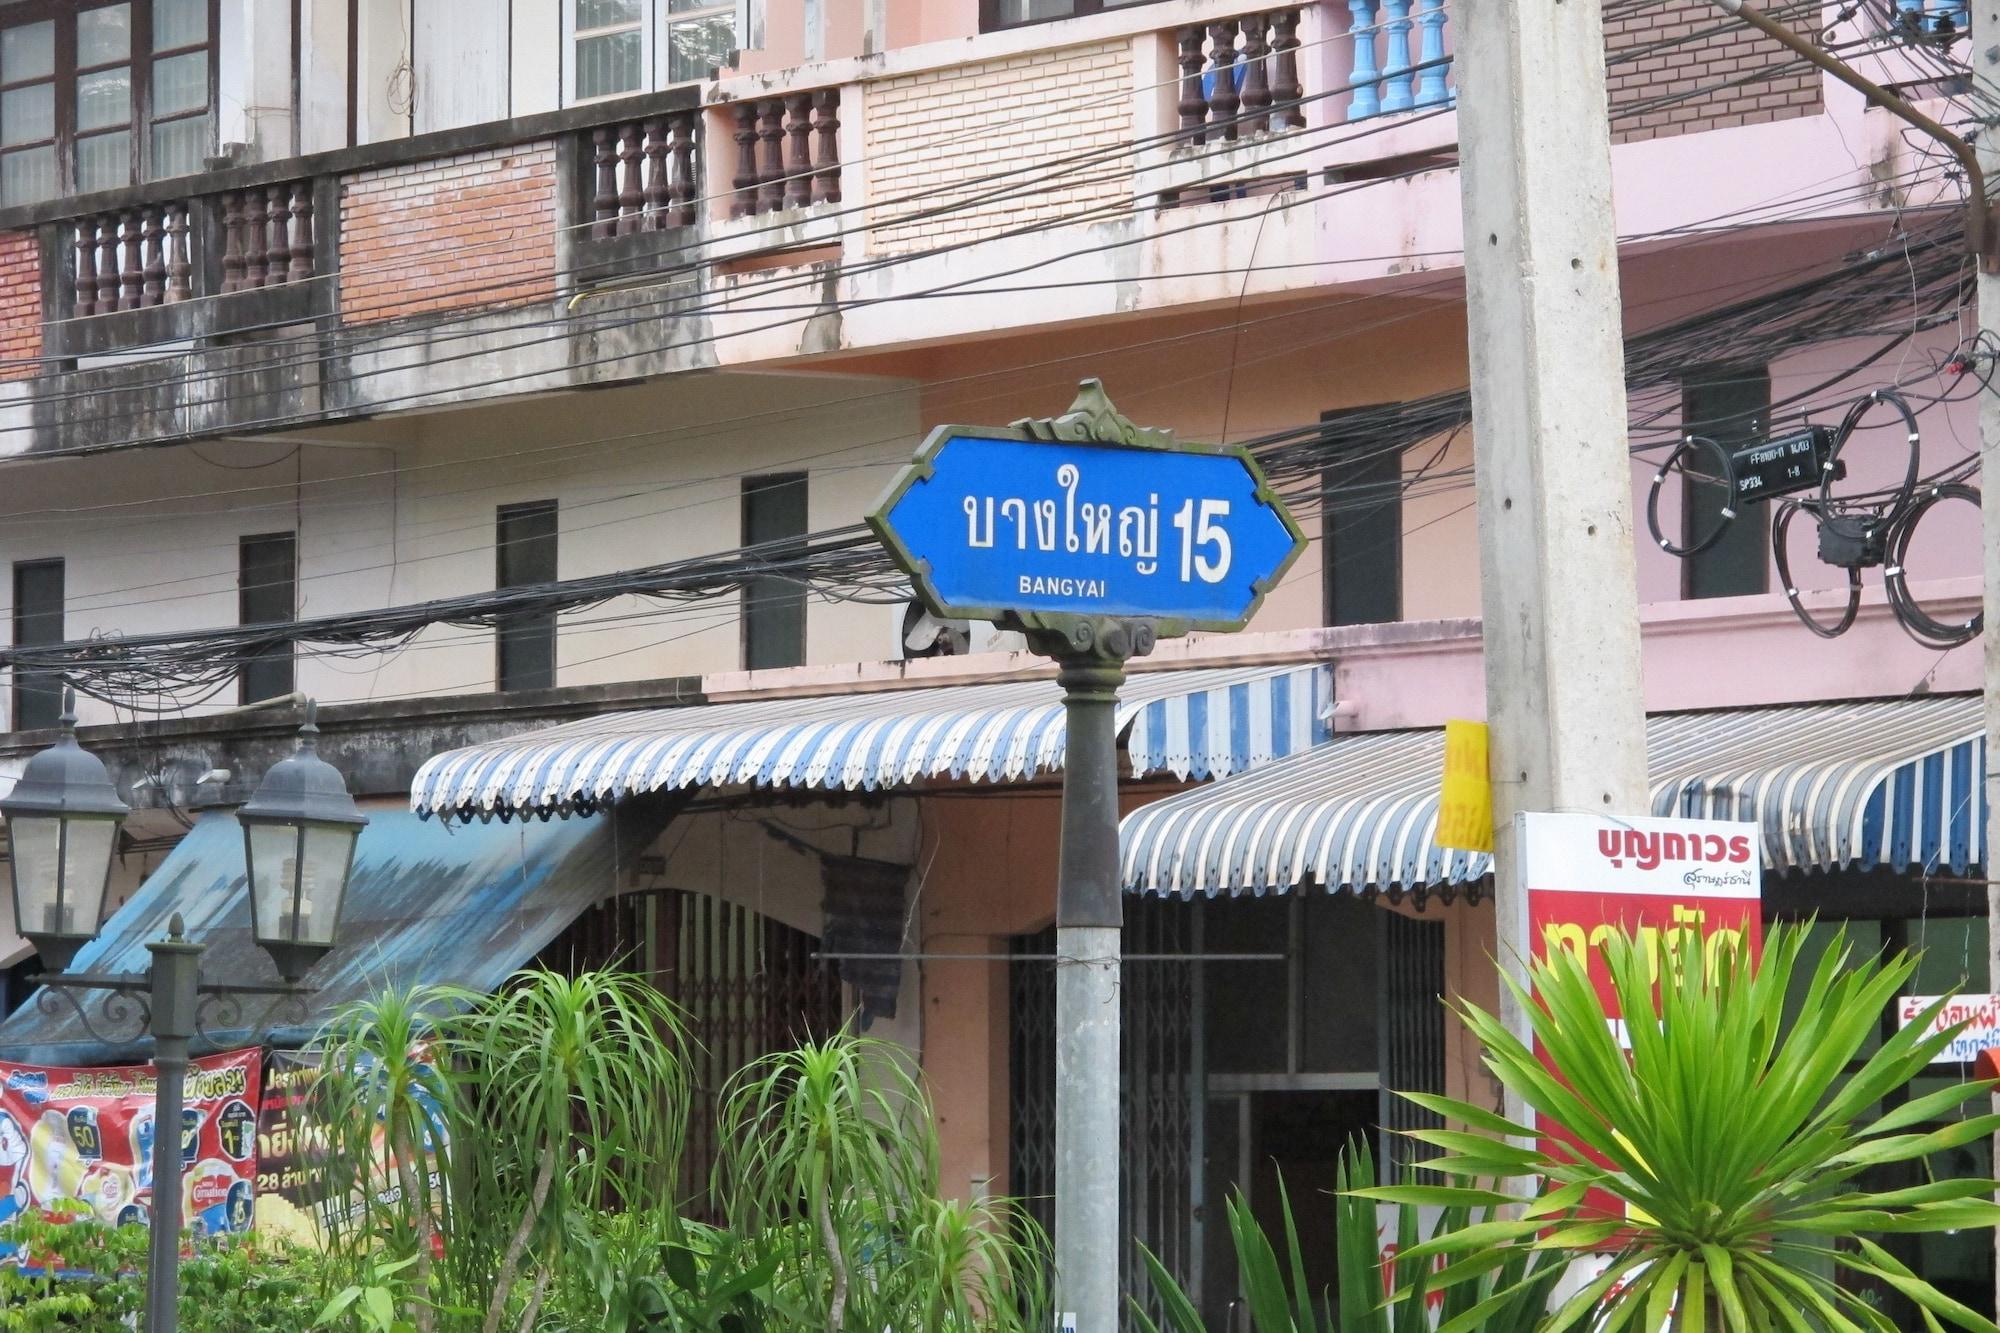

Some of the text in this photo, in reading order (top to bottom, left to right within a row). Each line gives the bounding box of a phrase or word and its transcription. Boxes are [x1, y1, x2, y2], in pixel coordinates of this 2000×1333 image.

[962, 463, 1232, 584] บางใหญ่ 15
[1018, 575, 1105, 599] BANGYAI
[1597, 828, 1752, 871] บุญถาวร
[73, 1125, 95, 1149] 50
[257, 1173, 279, 1191] 28
